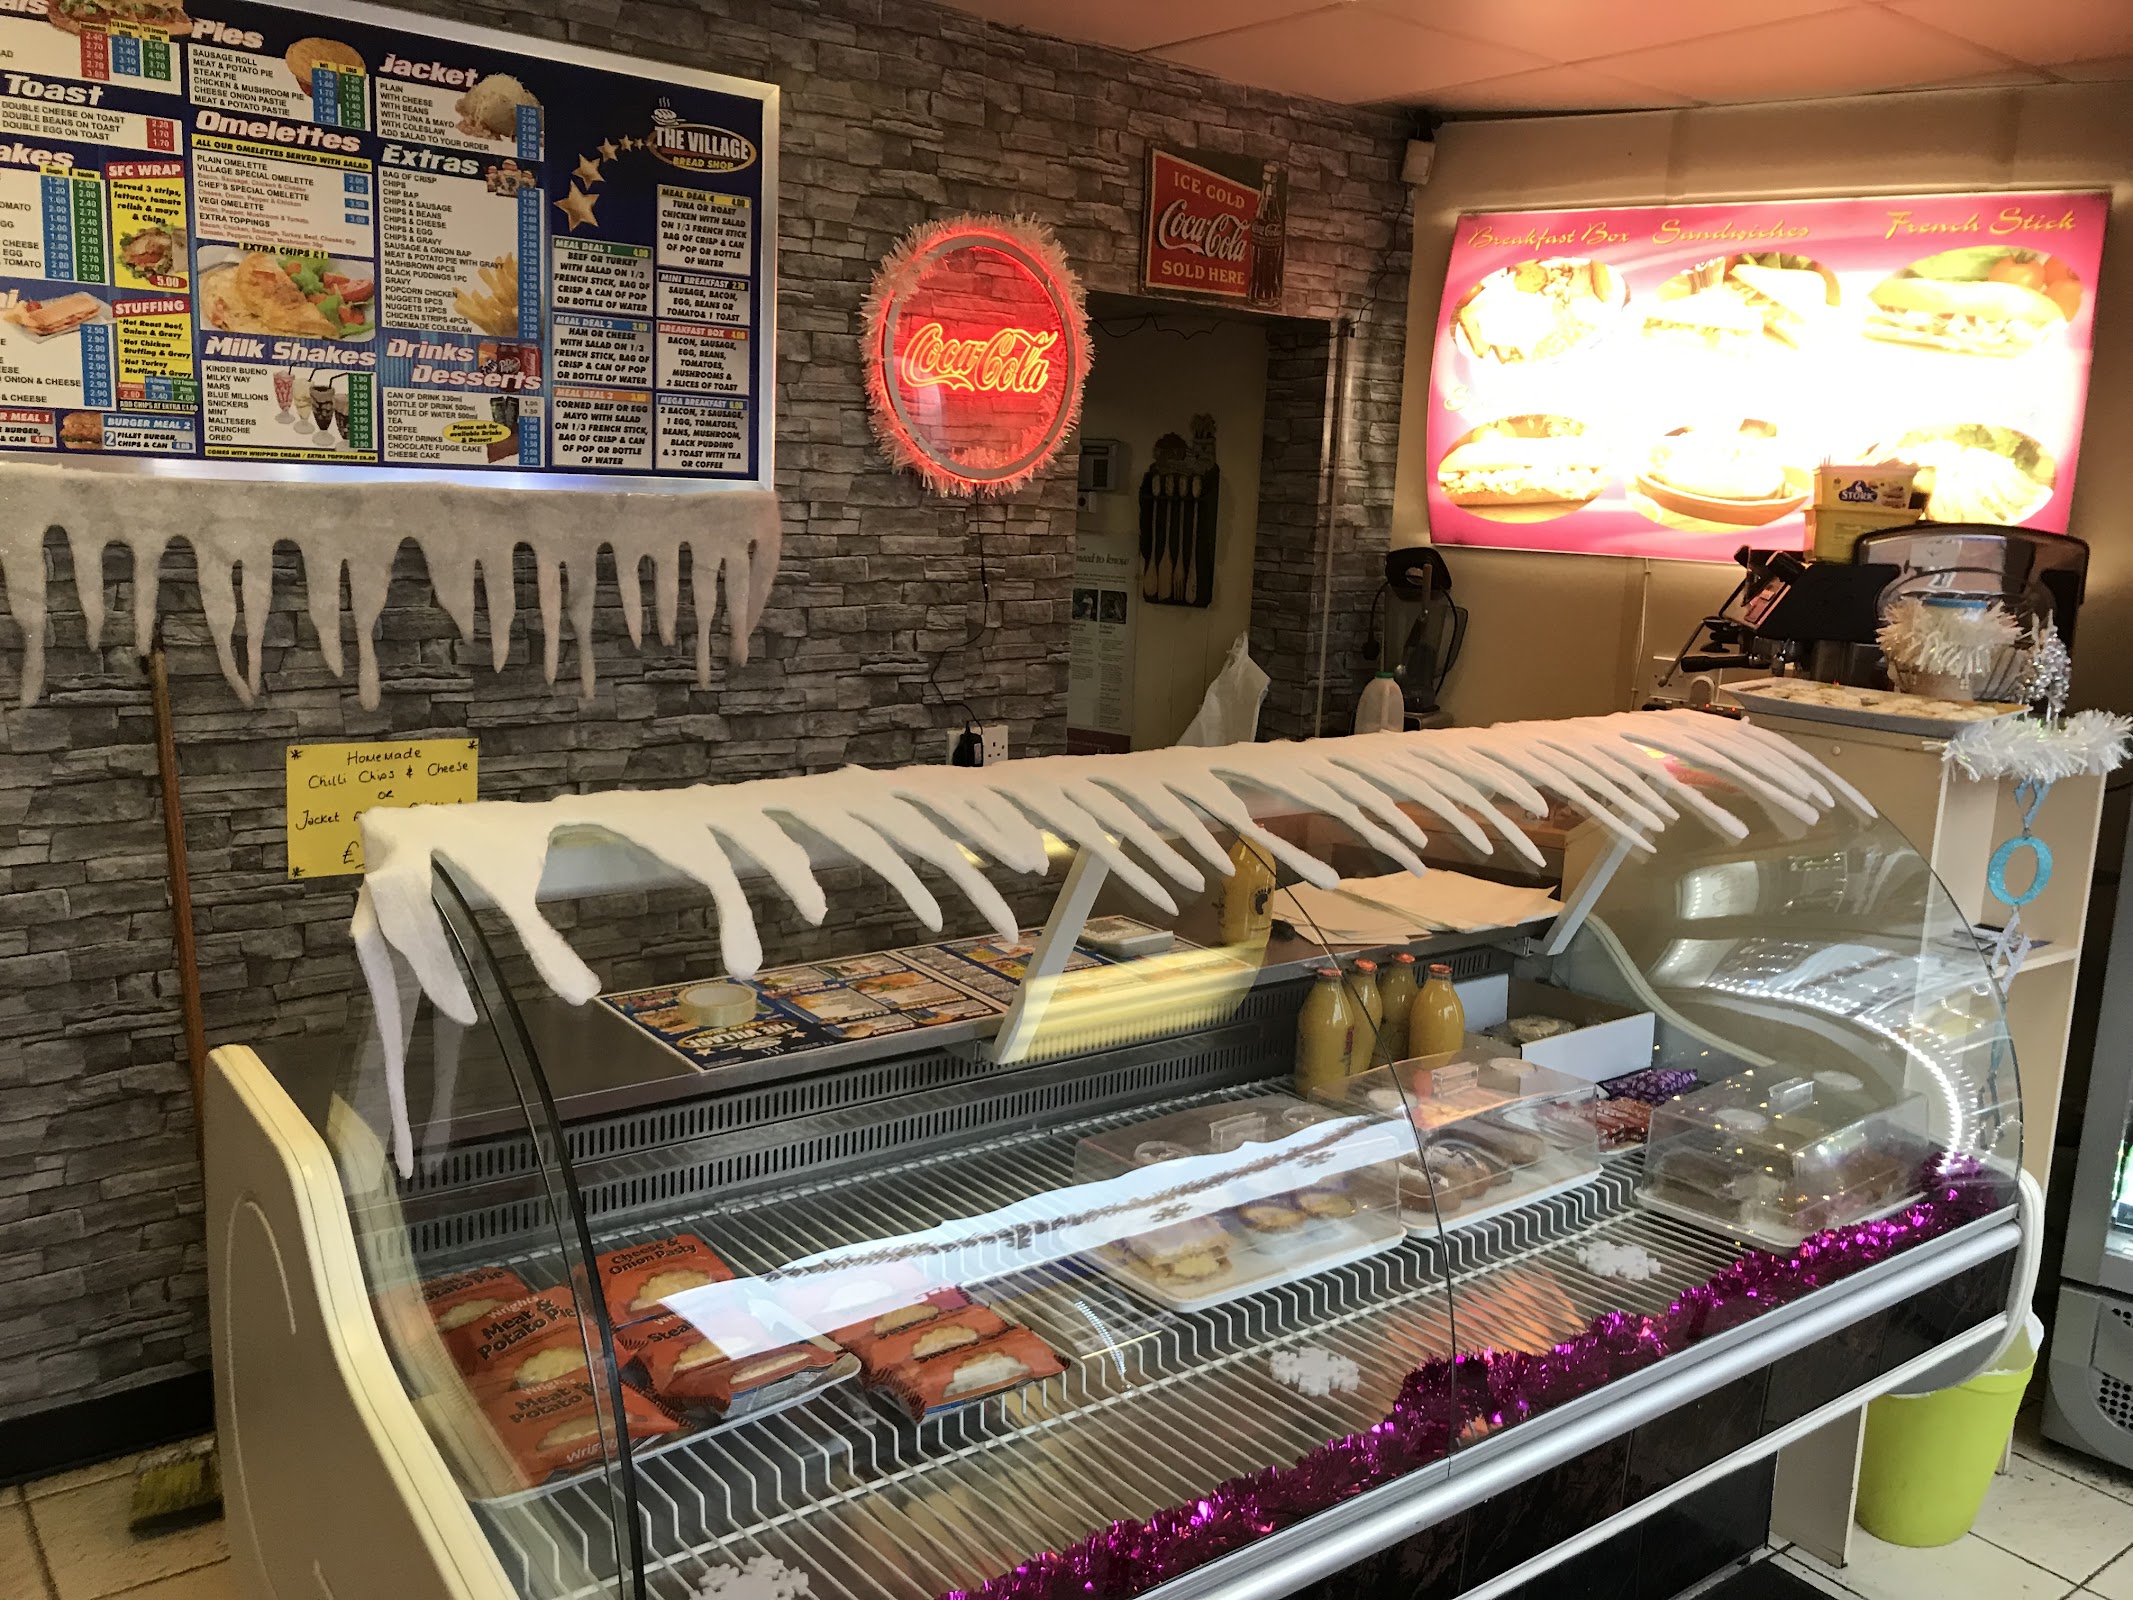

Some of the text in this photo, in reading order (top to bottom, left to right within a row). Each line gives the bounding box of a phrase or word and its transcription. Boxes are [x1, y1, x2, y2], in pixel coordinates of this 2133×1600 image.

[191, 17, 264, 48] Pies
[193, 49, 257, 66] SAUSAGE ROLL
[193, 58, 215, 68] MEAT
[227, 64, 258, 76] POTATO
[260, 69, 273, 78] PIE
[194, 68, 236, 80] STEAK PIE
[379, 53, 478, 88] Jacket
[4, 74, 103, 106] Toast
[194, 77, 231, 89] CHICKEN
[242, 84, 289, 98] MUSHROOM
[292, 92, 304, 100] PIE
[194, 86, 286, 107] CHEESE ONION PASTIE
[380, 83, 403, 92] PLAIN
[195, 95, 217, 106] MEAT
[228, 101, 259, 112] POTATO
[262, 105, 289, 116] PASTIE
[380, 92, 433, 107] WITH CHEESE
[2, 102, 125, 124] DOUBLE CHEESE ON TOAST
[2, 111, 120, 132] DOUBLE BEANS ON TOAST
[3, 121, 109, 140] DOUBLE EGG ON TOAST
[196, 110, 361, 152] Omelettes
[382, 129, 398, 137] ADD
[401, 132, 426, 142] SALAD
[440, 137, 461, 147] YOUR
[463, 142, 489, 151] ORDER
[654, 126, 749, 160] THE VILLAGE
[0, 142, 75, 168] akes
[196, 139, 368, 169] ALL OUR OMELETTES SERVED WITH SALAD
[197, 155, 267, 171] PLAIN OMELETTE
[382, 143, 479, 175] Extras
[673, 156, 734, 170] BREAD SHOP
[108, 163, 181, 177] SFC WRAP
[197, 164, 232, 176] VILLAGE
[235, 170, 269, 180] SPECIAL
[272, 174, 314, 186] OMELETTE
[231, 184, 265, 195] SPECIAL
[268, 189, 309, 201] OMELETTE
[662, 188, 683, 198] MEAL
[687, 192, 706, 201] DEAL
[1174, 172, 1245, 209] ICE COLD
[199, 197, 218, 205] VEGI
[221, 200, 264, 211] OMELETTE
[1159, 199, 1250, 262] Coca-Cola
[1652, 219, 1809, 244] Sandwiches
[1885, 207, 2076, 240] French Stick
[555, 239, 579, 249] MEAL
[582, 243, 604, 252] DEAL
[1468, 222, 1629, 251] Breakfast Box
[243, 243, 276, 254] EXTRA
[280, 247, 309, 257] CHIPS
[661, 273, 729, 289] MINI BREAKFAST
[1162, 260, 1245, 284] SOLD HERE
[157, 277, 179, 288] 5.00
[116, 301, 184, 314] STUFFING
[386, 321, 472, 332] HOMEMADE COLESLAW
[555, 316, 580, 325] MEAL
[659, 324, 724, 336] BREAKFAST BOX
[205, 336, 376, 366] Milk Shakes
[386, 338, 474, 362] Drinks
[902, 323, 1058, 393] Coca-Cola
[206, 365, 267, 375] KINDER BUENO
[207, 374, 250, 383] MILKY WAY
[412, 364, 542, 390] Desserts
[207, 382, 230, 390] MARS
[556, 388, 580, 397] MEAL
[583, 390, 604, 398] DEAL
[208, 400, 248, 408] SNICKERS
[231, 392, 268, 401] MILLIONS
[660, 396, 727, 407] MEGA BREAKFAST
[108, 418, 150, 427] BURGER
[154, 420, 180, 429] MEAL
[1842, 491, 1875, 499] STORK
[1076, 553, 1130, 565] need to know
[296, 810, 339, 830] Jacket
[758, 1023, 797, 1032] THE
[685, 1029, 761, 1047] VILLAGE
[609, 1244, 697, 1274] Onion Pasty
[611, 1241, 665, 1264] Cheese
[424, 1281, 476, 1300] otato
[488, 1296, 539, 1319] Wrights
[478, 1305, 577, 1360] Potato Pie
[481, 1310, 535, 1340] Meat
[510, 1394, 582, 1423] Potato
[515, 1387, 571, 1410] Meat
